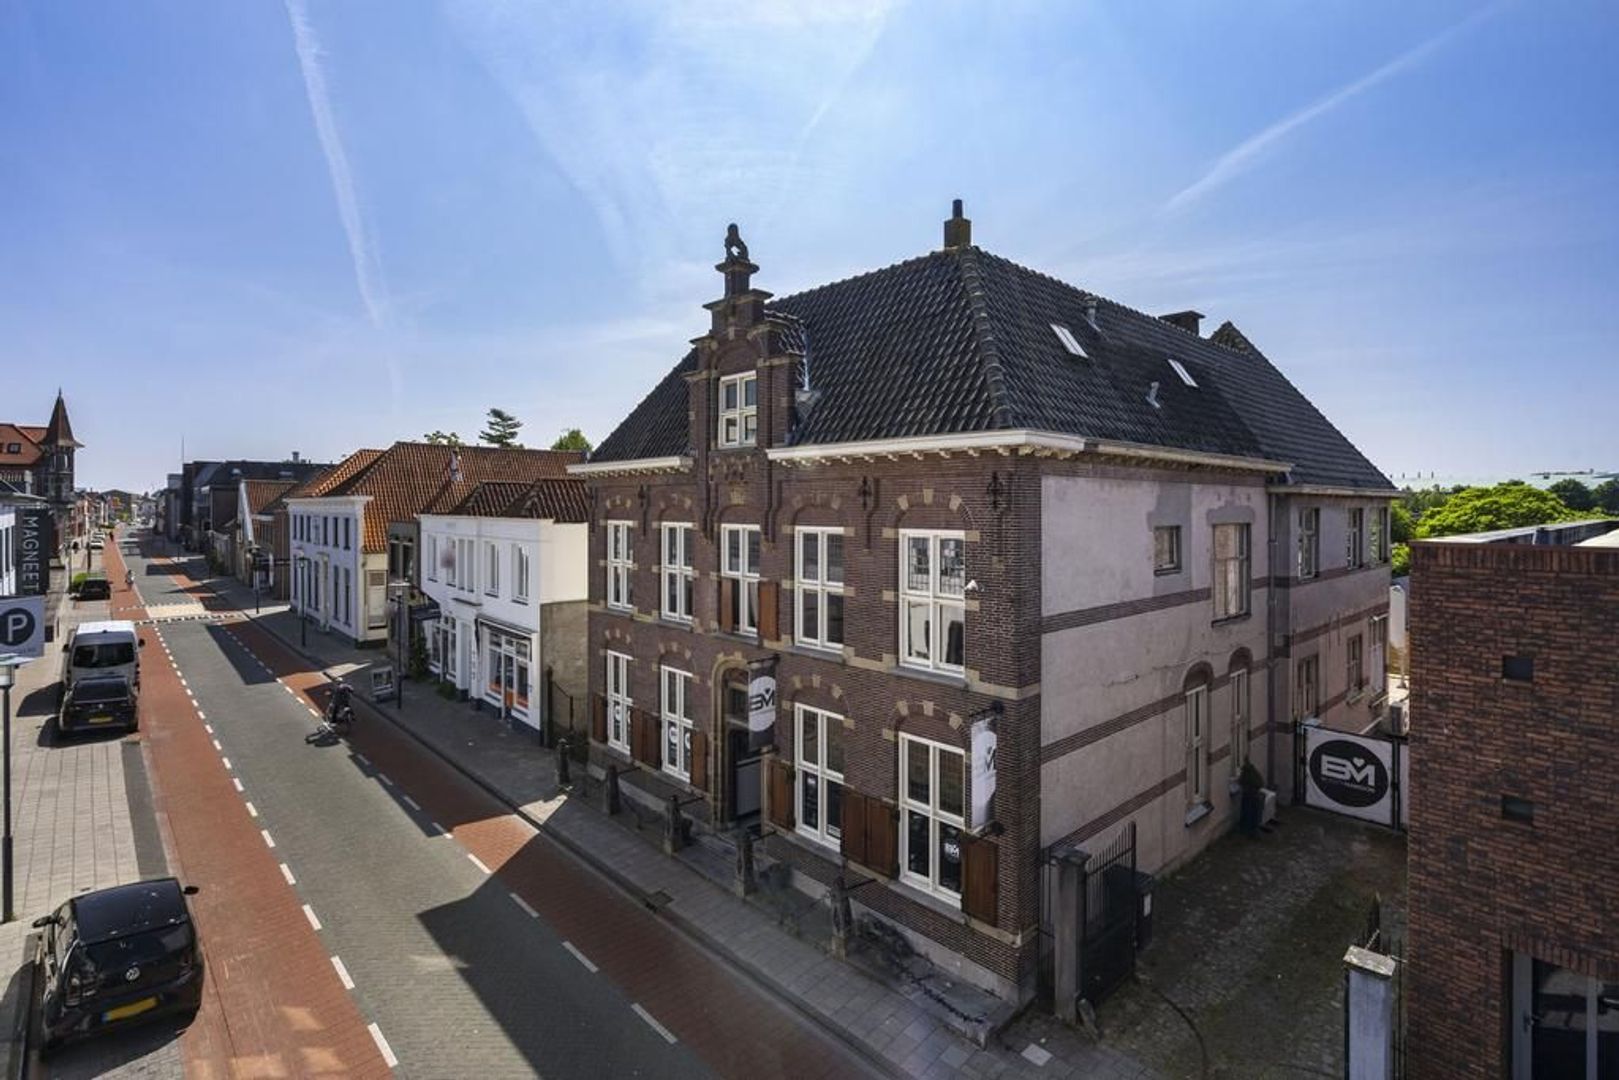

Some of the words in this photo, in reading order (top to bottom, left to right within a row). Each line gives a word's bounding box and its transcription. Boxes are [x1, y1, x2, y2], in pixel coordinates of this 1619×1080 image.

[22, 516, 39, 593] MAGNEET
[7, 614, 28, 643] P
[1321, 754, 1376, 787] BM
